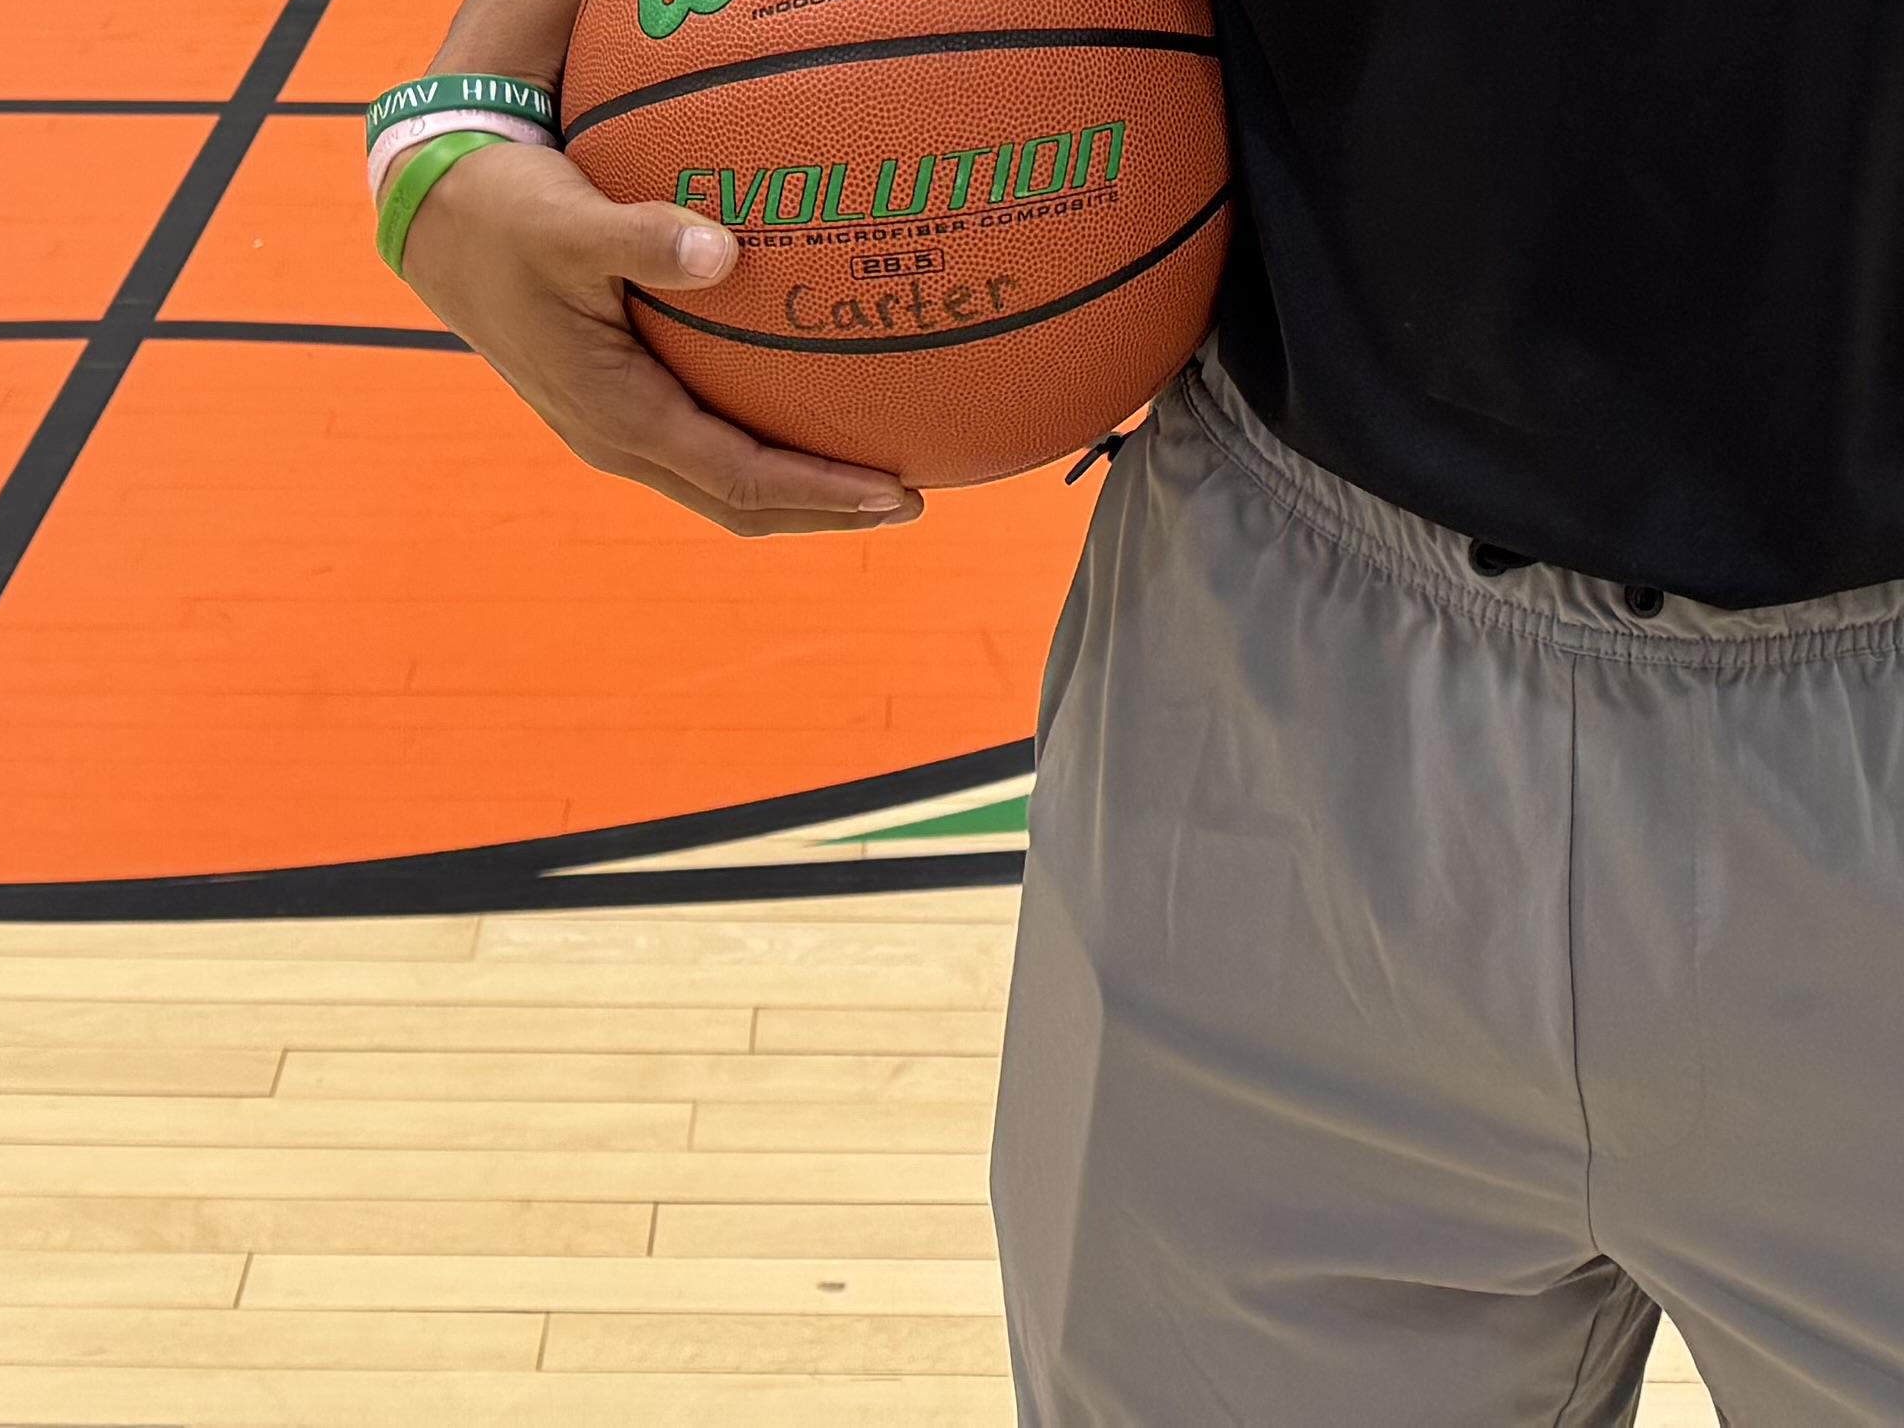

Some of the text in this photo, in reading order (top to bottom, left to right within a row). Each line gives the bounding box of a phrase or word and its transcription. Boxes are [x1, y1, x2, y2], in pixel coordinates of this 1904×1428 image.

[675, 120, 1126, 226] EVOLUTION
[806, 190, 1120, 245] MICROFIBER COMPOSITE
[862, 254, 934, 275] 28.5
[785, 274, 1019, 335] Carter
